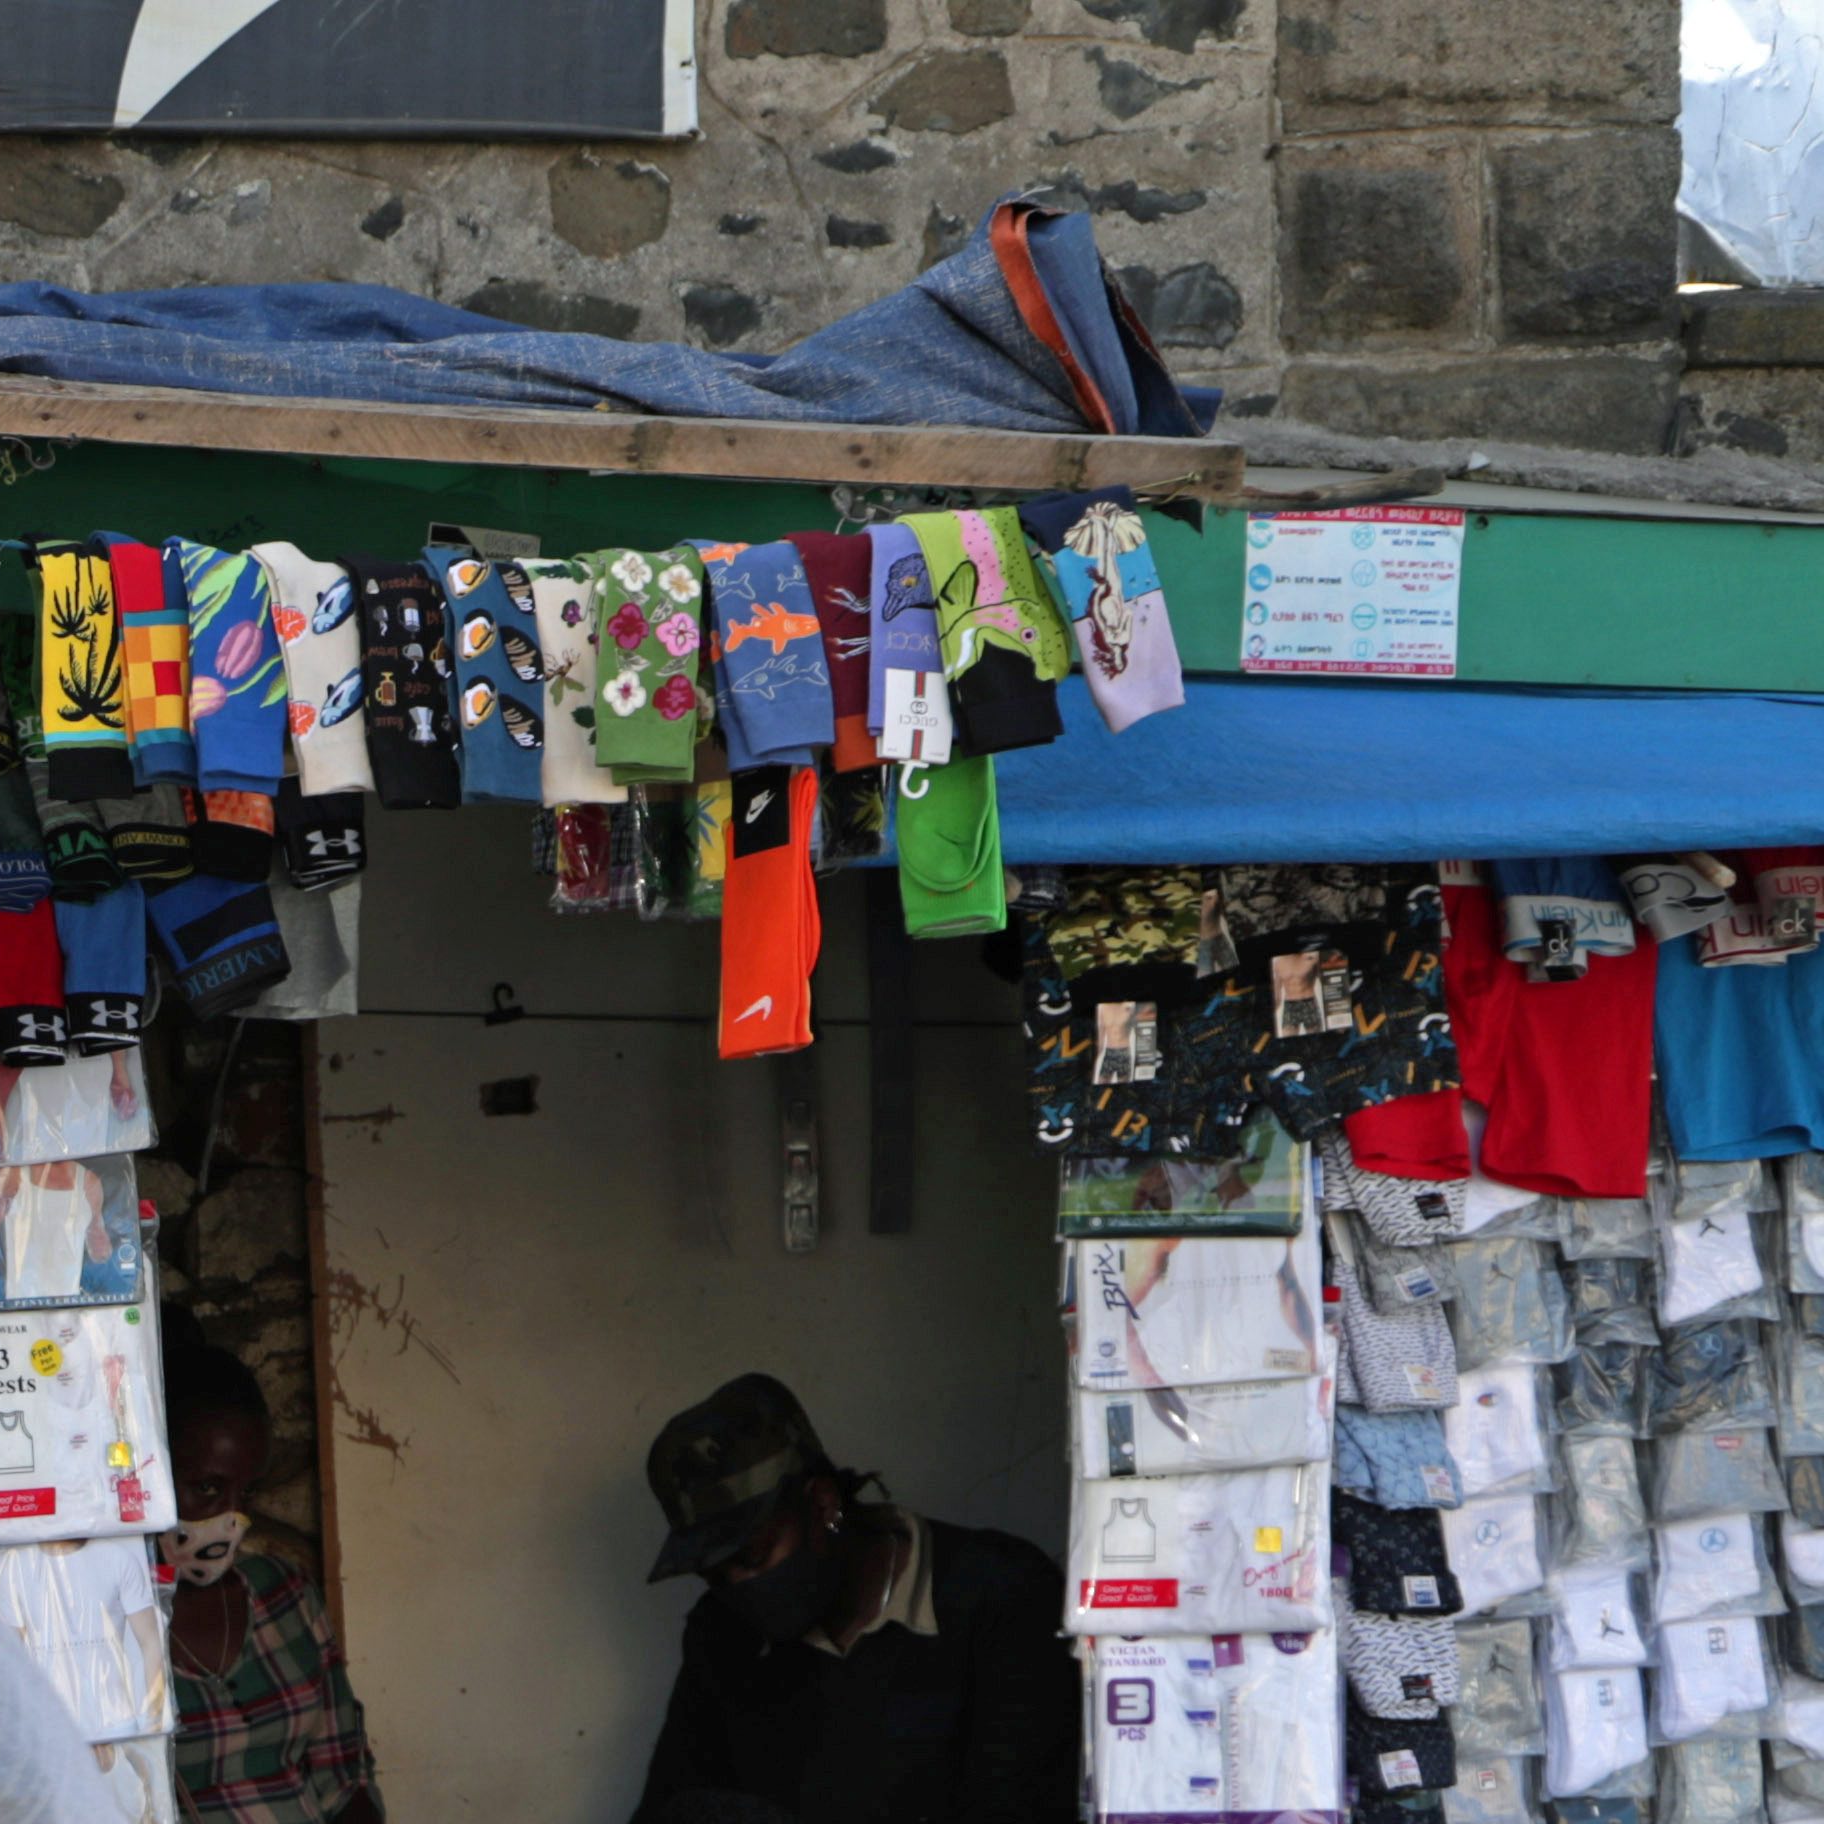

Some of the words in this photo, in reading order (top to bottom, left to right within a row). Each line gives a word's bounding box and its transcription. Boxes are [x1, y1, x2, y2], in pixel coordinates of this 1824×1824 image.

[899, 714, 938, 728] GUCCI
[1780, 909, 1807, 935] ck
[1547, 928, 1569, 954] ck
[1090, 1243, 1140, 1320] Brix
[30, 1344, 55, 1361] Free
[1102, 1583, 1128, 1594] Great
[1097, 1592, 1125, 1602] Great
[1109, 1645, 1157, 1657] VICTAN
[1100, 1656, 1166, 1668] STANDARD
[1115, 1683, 1150, 1721] 3
[1117, 1727, 1146, 1741] PCS
